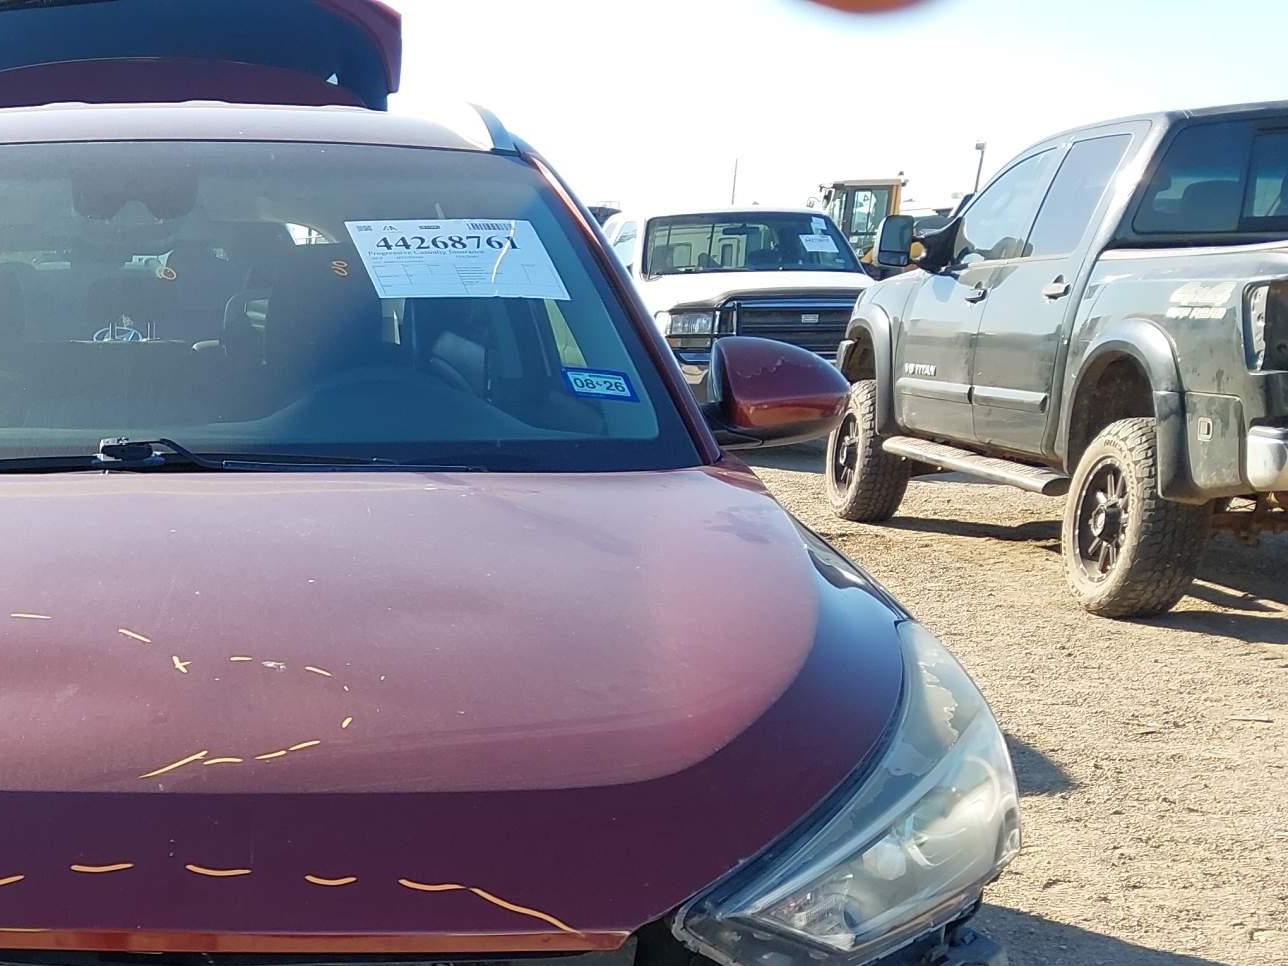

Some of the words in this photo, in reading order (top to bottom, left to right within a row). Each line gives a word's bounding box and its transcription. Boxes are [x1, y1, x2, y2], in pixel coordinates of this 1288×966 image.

[376, 235, 520, 251] 44268761
[915, 363, 937, 376] TITAN
[603, 380, 626, 392] 26
